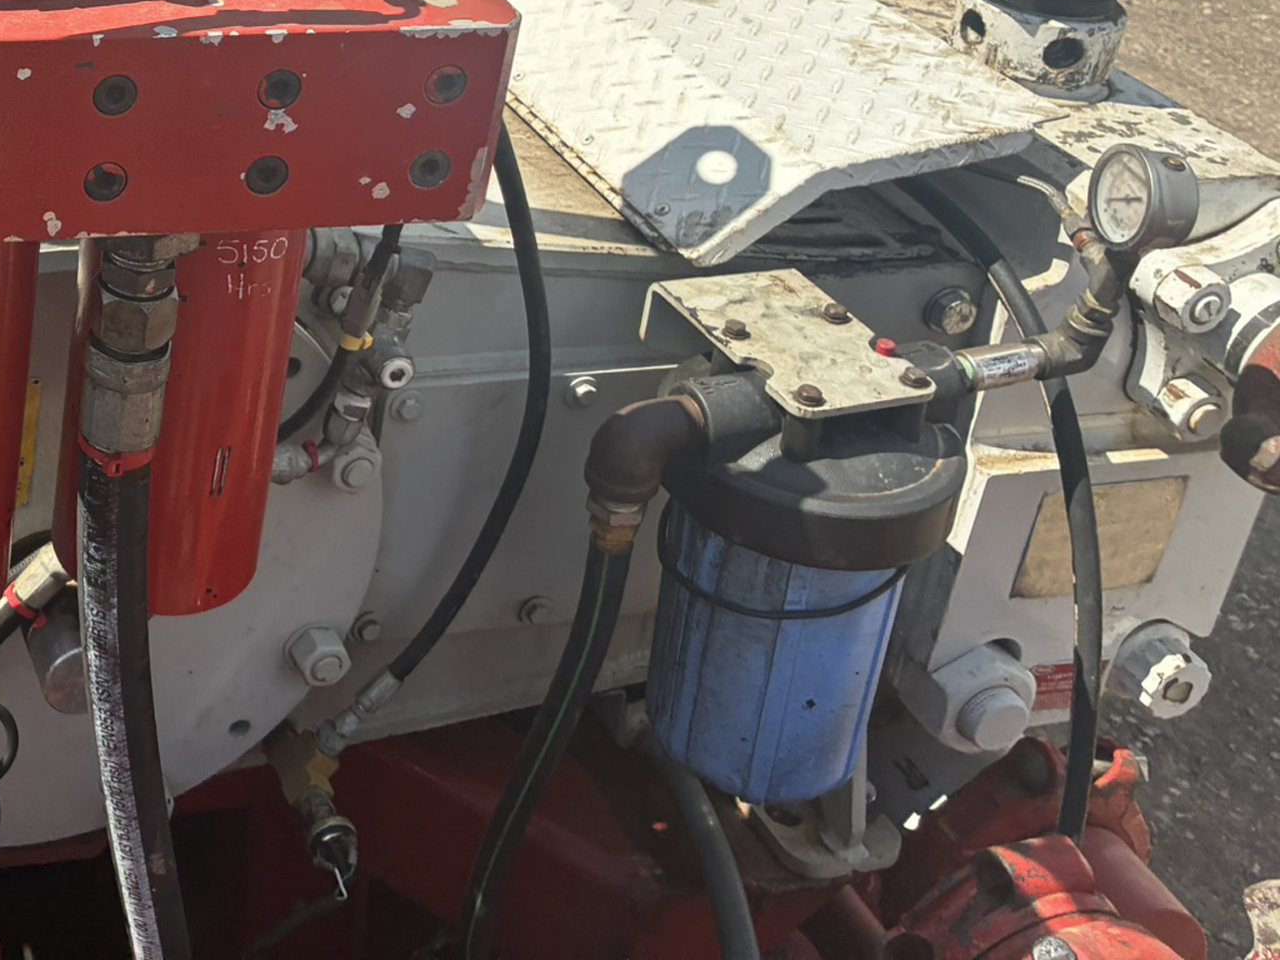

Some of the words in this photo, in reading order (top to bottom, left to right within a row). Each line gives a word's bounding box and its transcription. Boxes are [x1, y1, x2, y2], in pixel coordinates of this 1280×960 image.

[217, 238, 289, 264] 5150
[226, 273, 272, 300] Hrs
[99, 707, 116, 751] EN853
